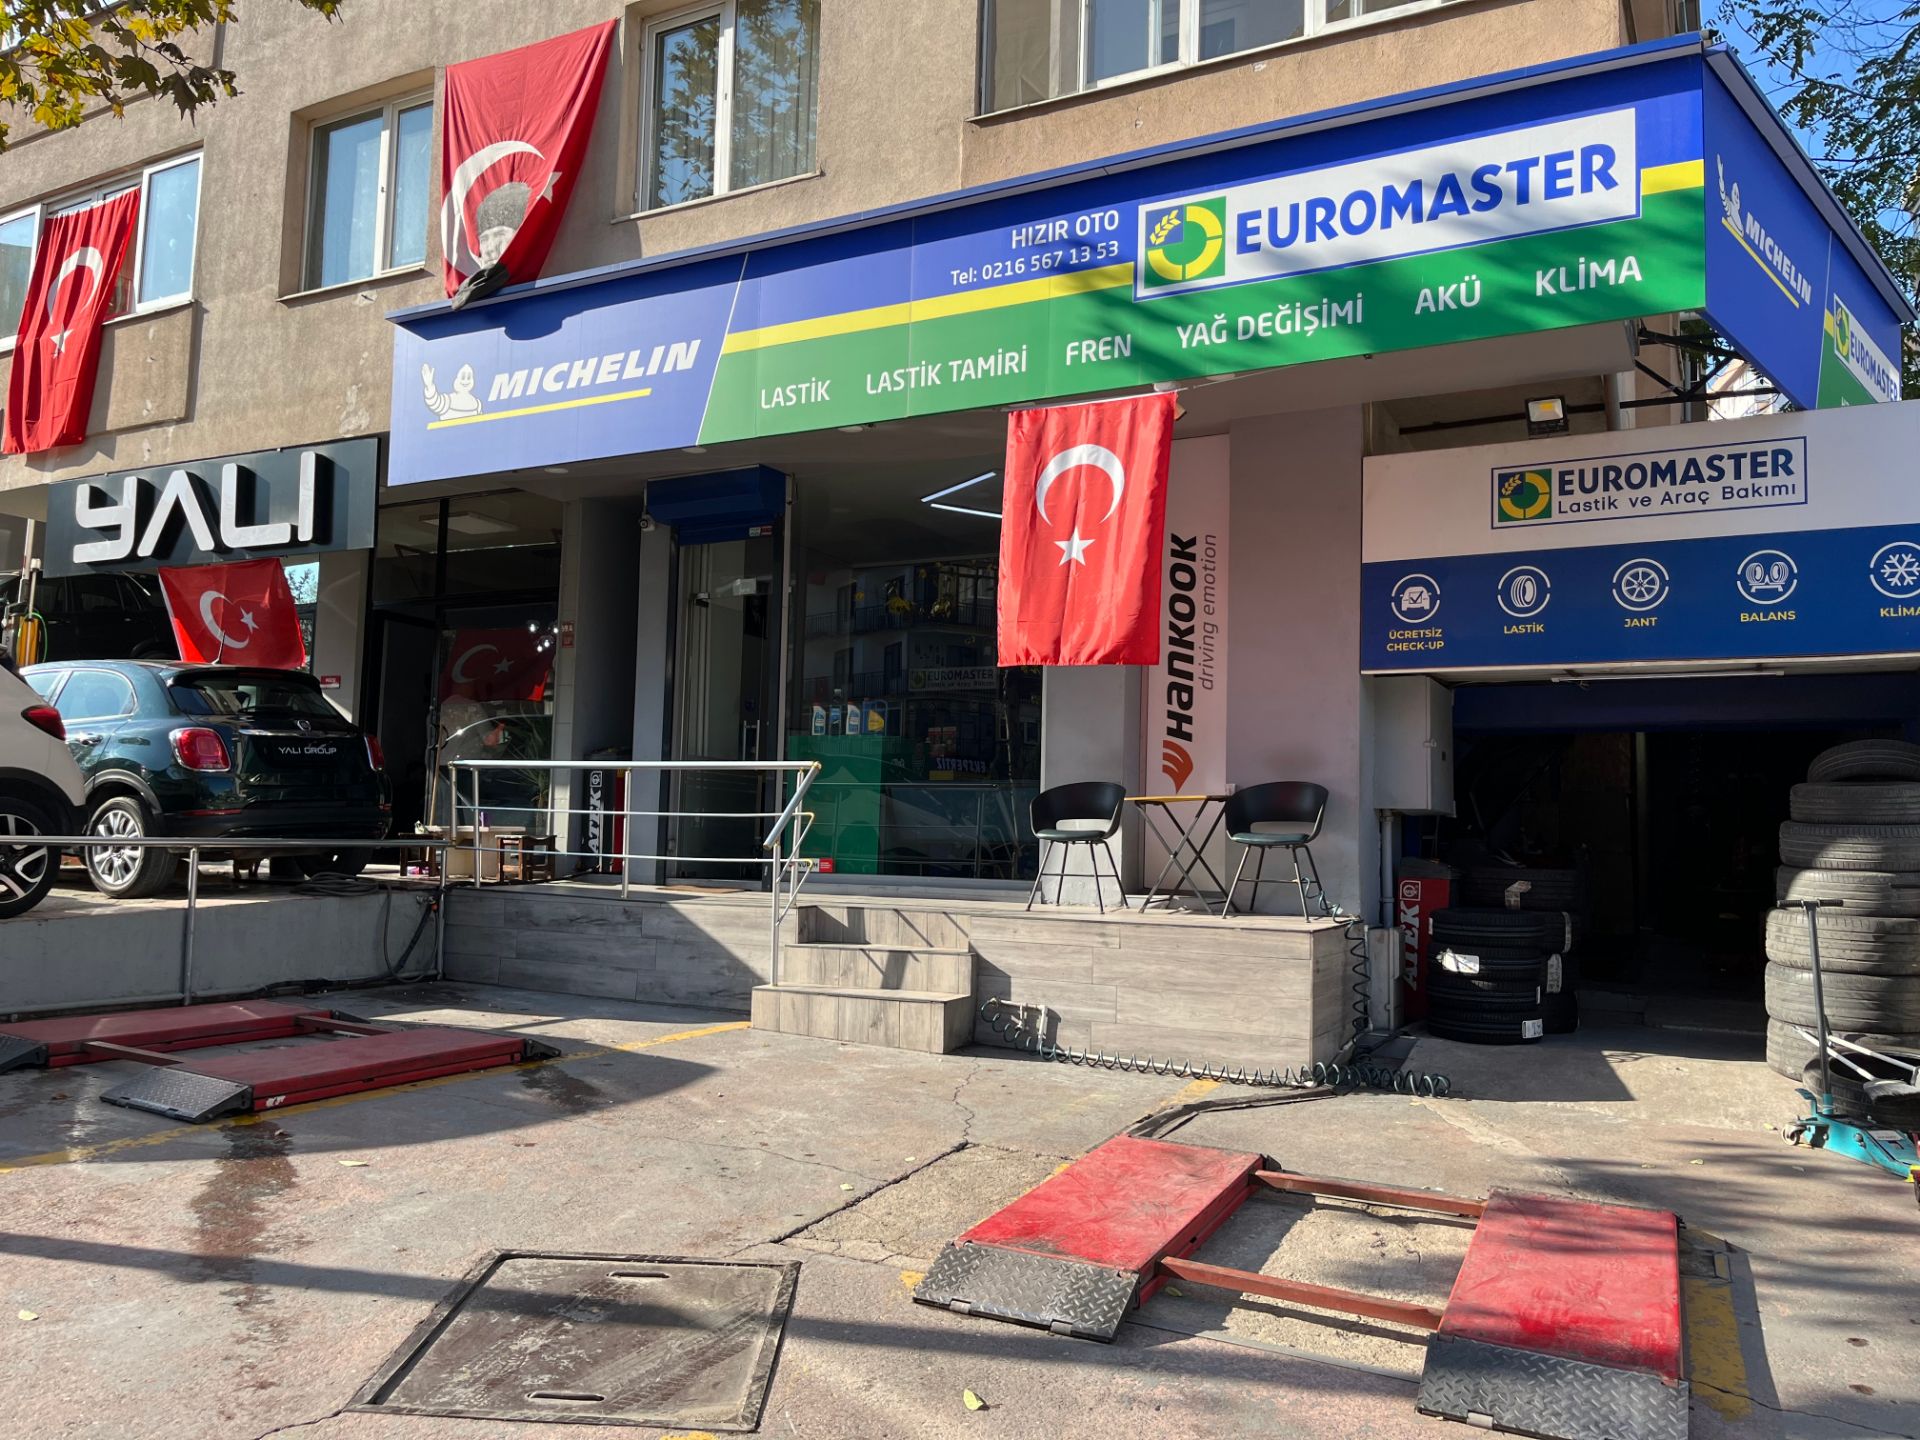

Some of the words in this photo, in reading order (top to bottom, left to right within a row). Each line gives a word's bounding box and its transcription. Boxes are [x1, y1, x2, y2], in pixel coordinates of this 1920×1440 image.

[1236, 143, 1619, 255] EUROMASTER
[1011, 220, 1068, 249] HIZIR
[1075, 210, 1119, 236] OTO
[951, 267, 977, 286] Tel:
[982, 258, 1025, 280] 0216
[1030, 251, 1063, 272] 567
[1069, 246, 1090, 264] 13
[1096, 240, 1119, 259] 53
[1536, 255, 1642, 296] KLİMA
[1746, 211, 1811, 305] MICHELIN
[1414, 275, 1482, 315] AKÜ
[1177, 304, 1227, 349] YAĞ
[1237, 292, 1364, 342] DEĞİŞİMİ
[488, 339, 701, 402] MICHELIN
[866, 360, 941, 394] LASTİK
[948, 345, 1027, 383] TAMİRİ
[1066, 334, 1132, 366] FREN
[1850, 331, 1899, 401] EUROMASTER
[760, 377, 831, 409] LASTİK
[1558, 449, 1795, 496] EUROMASTER
[73, 451, 315, 564] YALI
[1558, 495, 1618, 514] Lastik
[1629, 496, 1652, 508] ve
[1660, 488, 1710, 505] Araç
[1722, 482, 1796, 499] Bakımı
[1200, 534, 1217, 616] emotion
[1389, 627, 1442, 640] ÜCRETSİZ
[1503, 623, 1545, 634] LASTİK
[1624, 617, 1657, 628] JANT
[1740, 610, 1796, 622] BALANS
[1198, 620, 1219, 690] driving
[1386, 640, 1444, 652] CHECK-UP
[279, 746, 301, 755] YALI
[304, 746, 337, 755] GROUP
